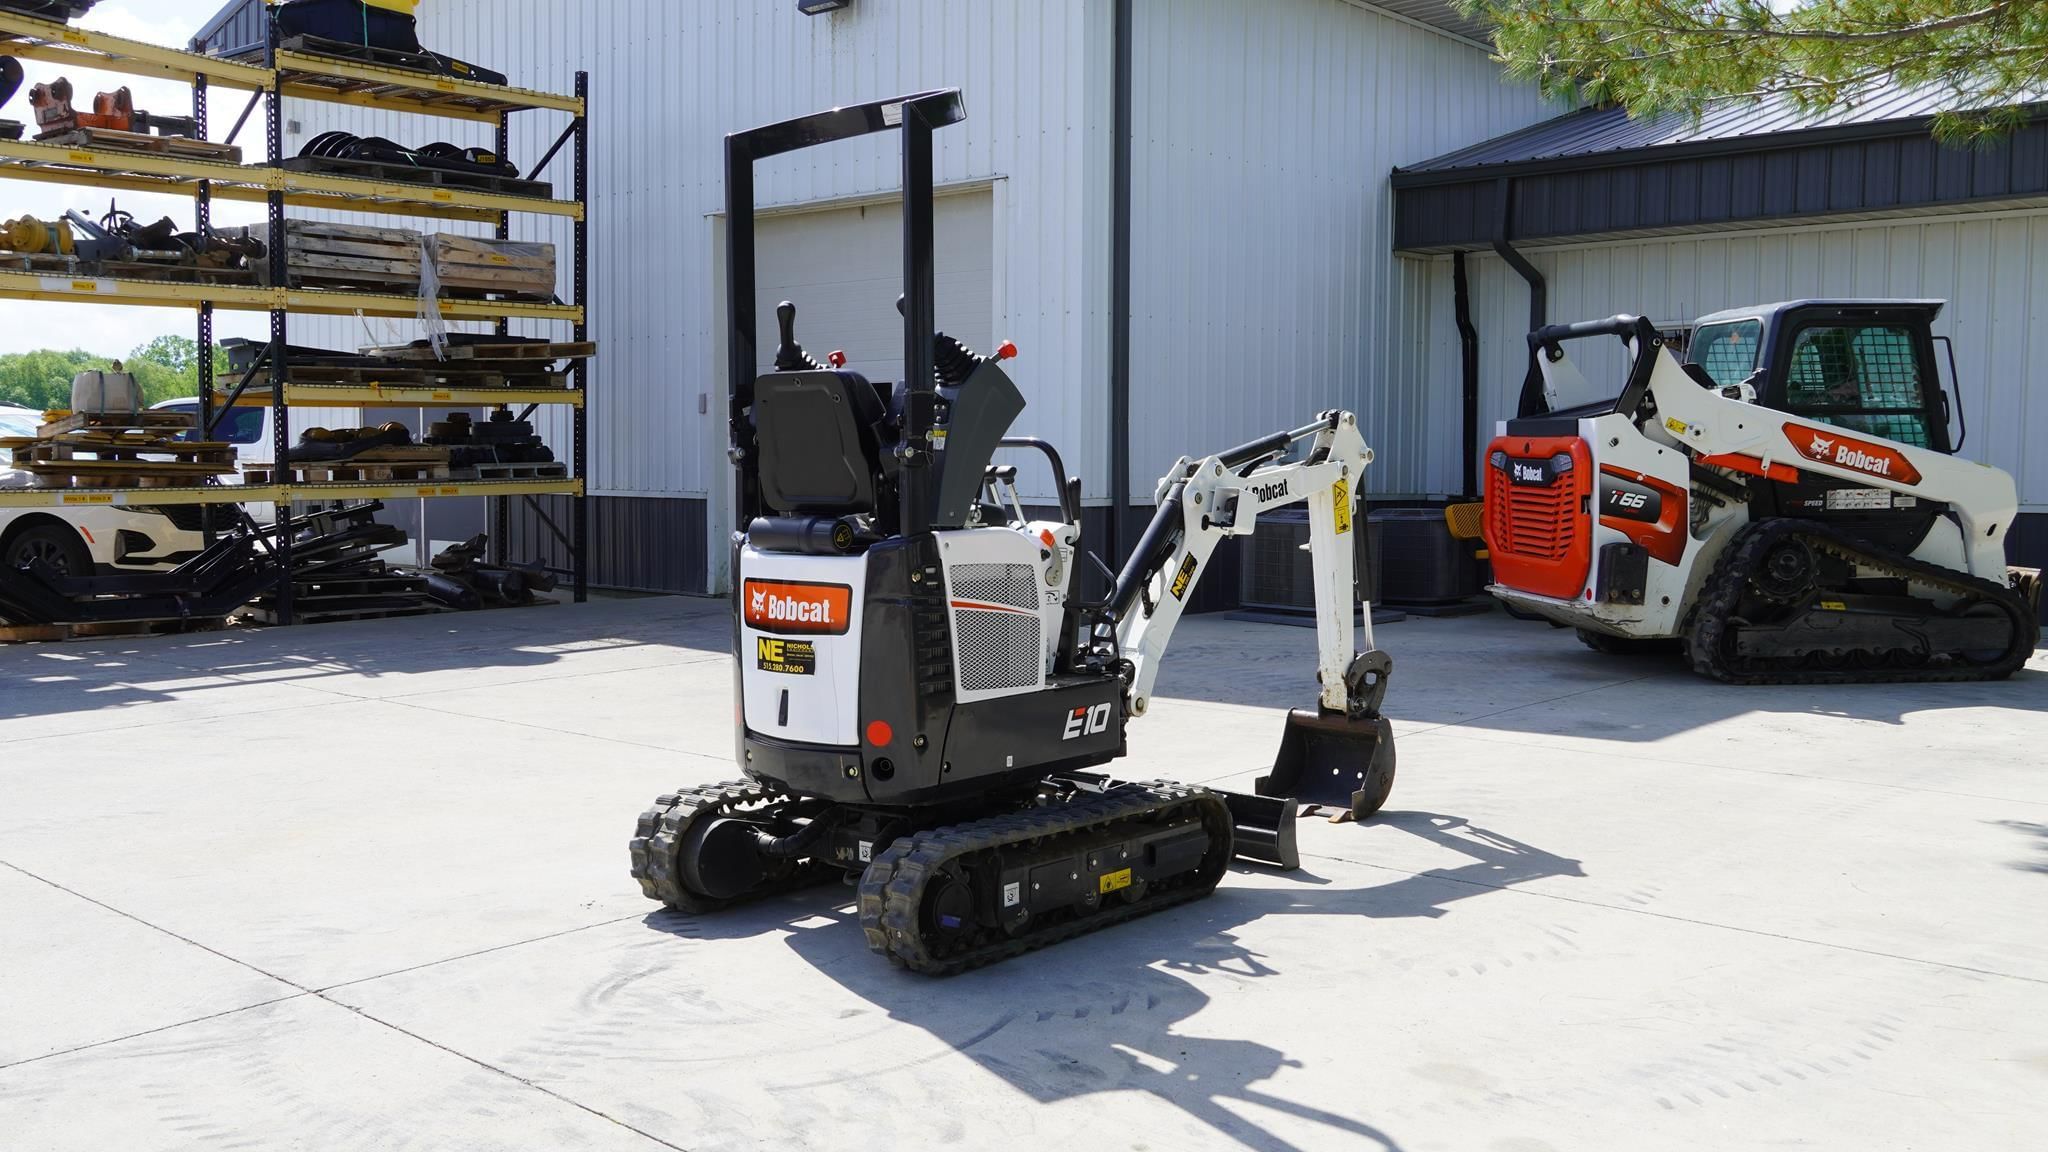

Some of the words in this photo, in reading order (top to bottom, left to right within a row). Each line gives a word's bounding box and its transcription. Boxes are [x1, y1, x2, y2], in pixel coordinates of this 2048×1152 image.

[1835, 445, 1890, 474] Bobcat
[1522, 466, 1543, 481] Bobcat
[1609, 490, 1647, 508] T66
[1172, 569, 1187, 596] NE
[768, 594, 830, 623] Bobcat
[758, 638, 785, 662] NE
[763, 663, 804, 673] 515.280.7600
[1062, 702, 1112, 740] E10
